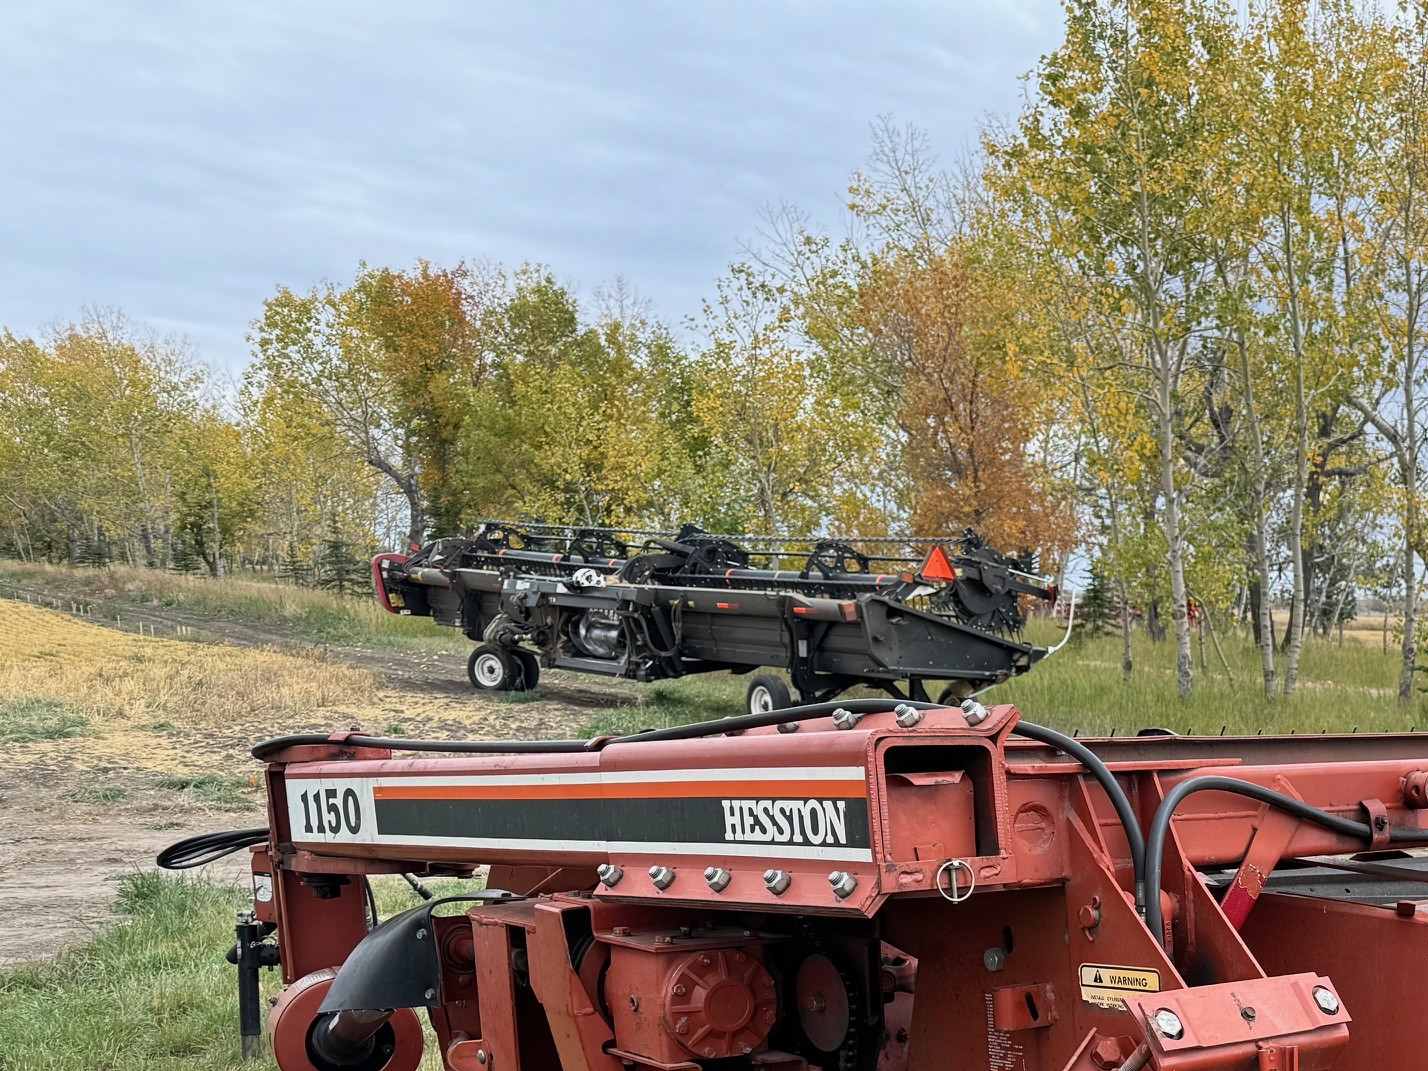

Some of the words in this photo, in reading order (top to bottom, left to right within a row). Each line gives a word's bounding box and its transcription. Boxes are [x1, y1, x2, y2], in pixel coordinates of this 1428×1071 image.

[301, 788, 361, 835] 1150
[721, 799, 847, 845] HESSTON
[1109, 975, 1148, 988] WARNING
